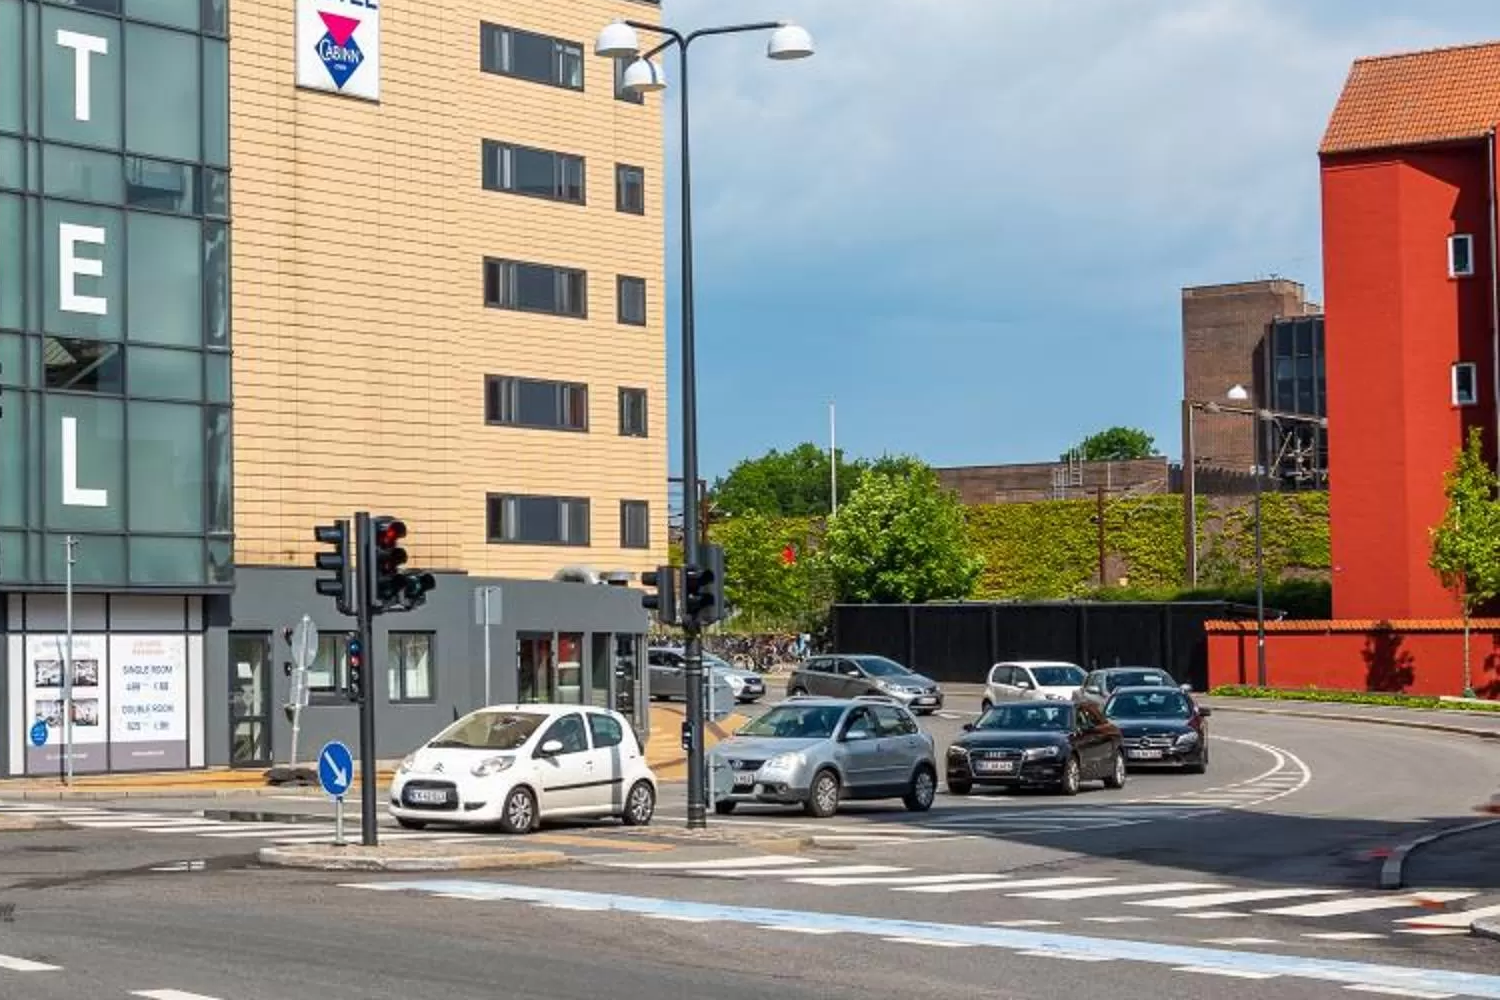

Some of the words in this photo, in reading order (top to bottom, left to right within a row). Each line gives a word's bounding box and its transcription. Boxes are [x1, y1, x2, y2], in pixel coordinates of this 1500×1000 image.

[123, 665, 149, 675] SINGLE
[151, 665, 173, 675] ROOM
[152, 704, 174, 713] ROOM
